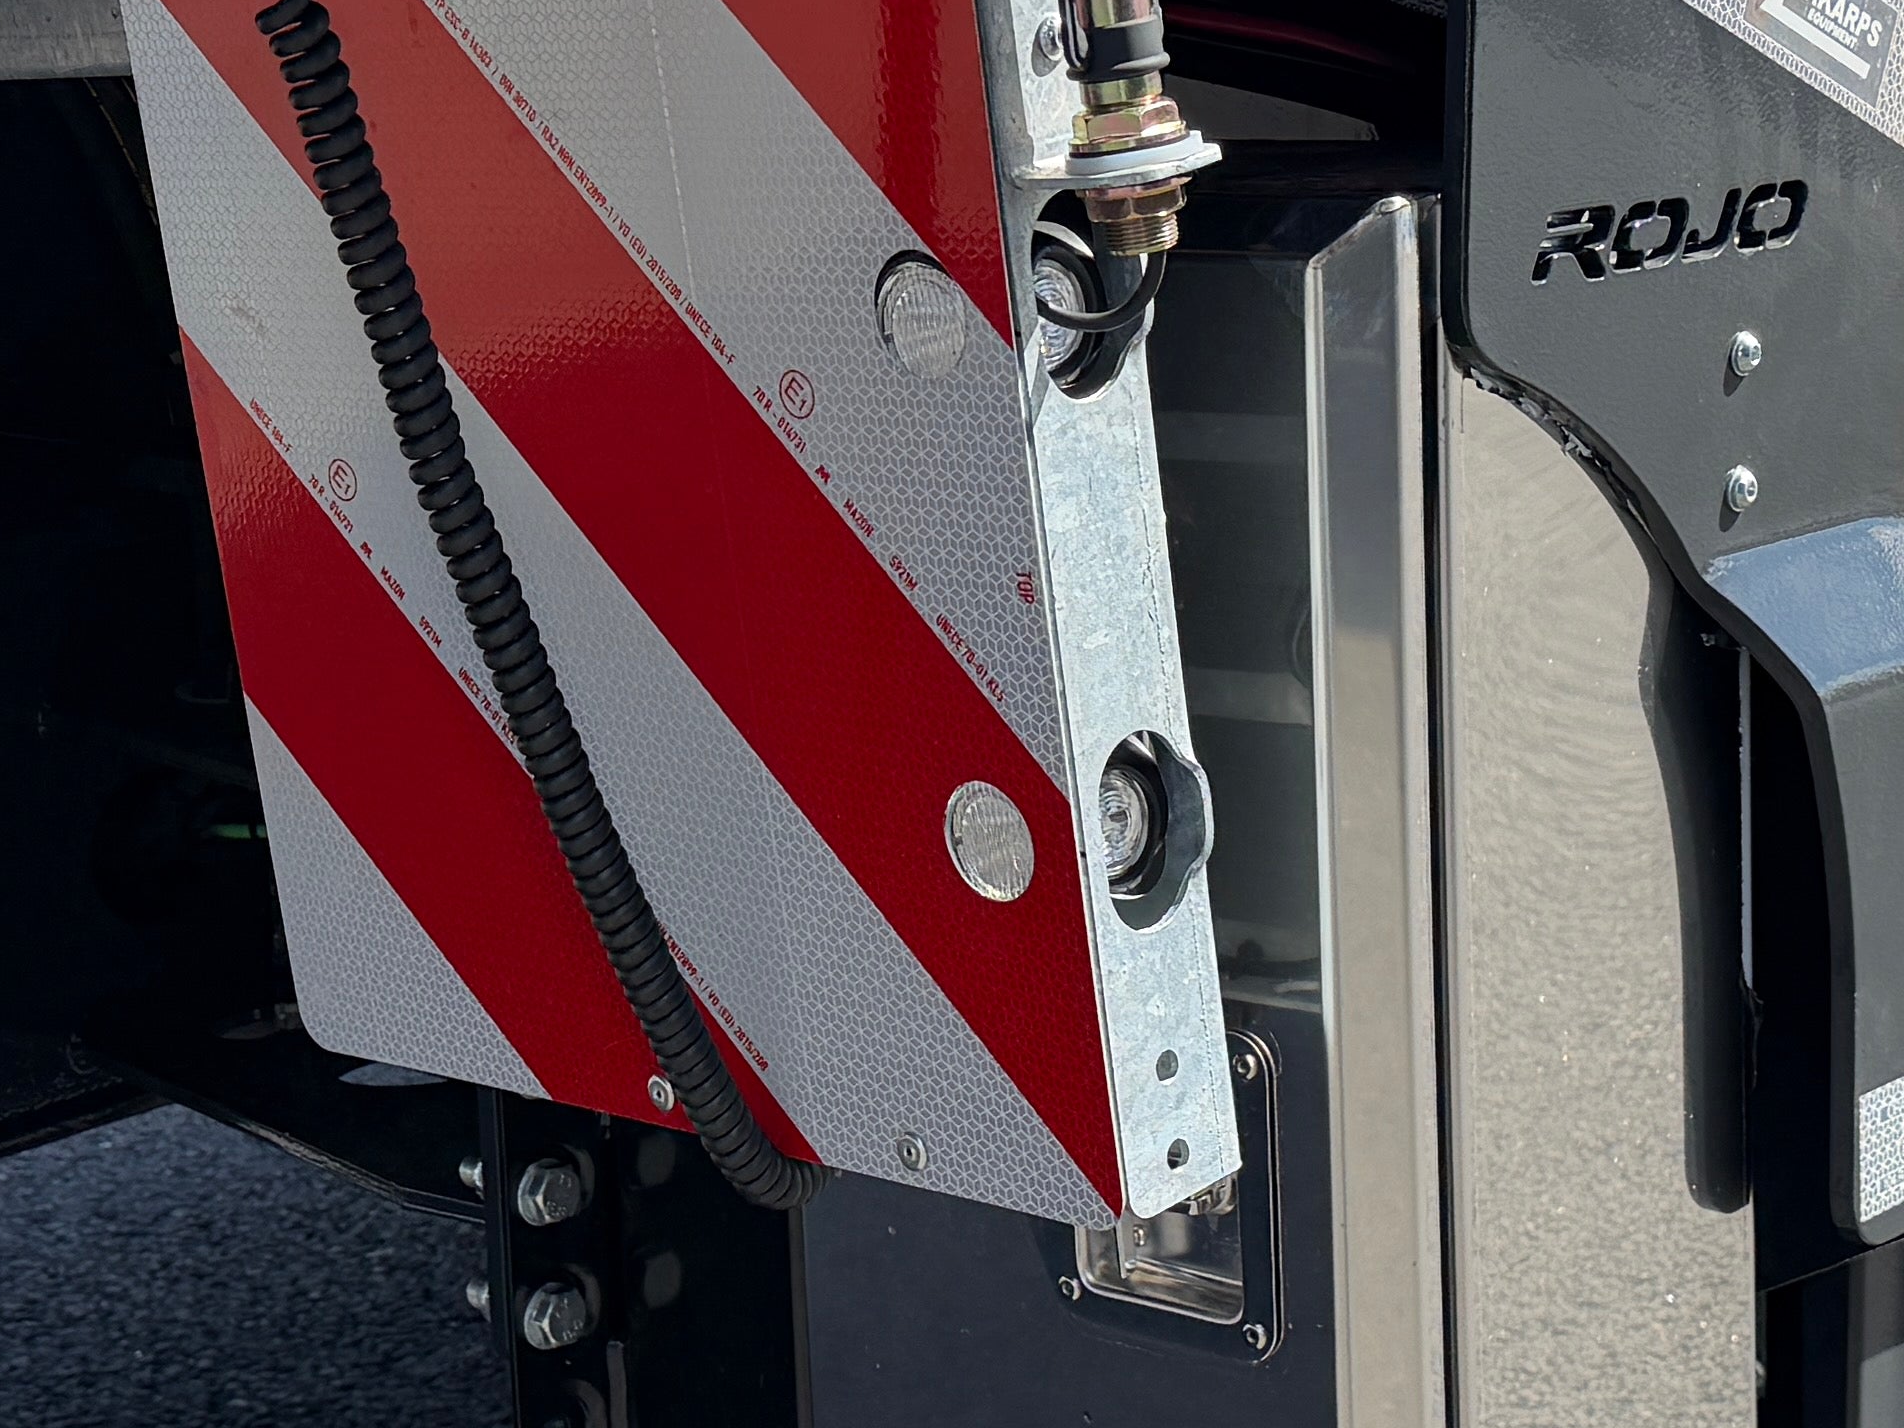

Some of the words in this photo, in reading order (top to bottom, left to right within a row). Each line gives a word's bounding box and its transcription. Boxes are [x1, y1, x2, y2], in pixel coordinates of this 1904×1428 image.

[1531, 178, 1810, 286] ROJO
[784, 377, 807, 412] E1
[332, 464, 351, 495] E1
[1016, 571, 1035, 605] TOP
